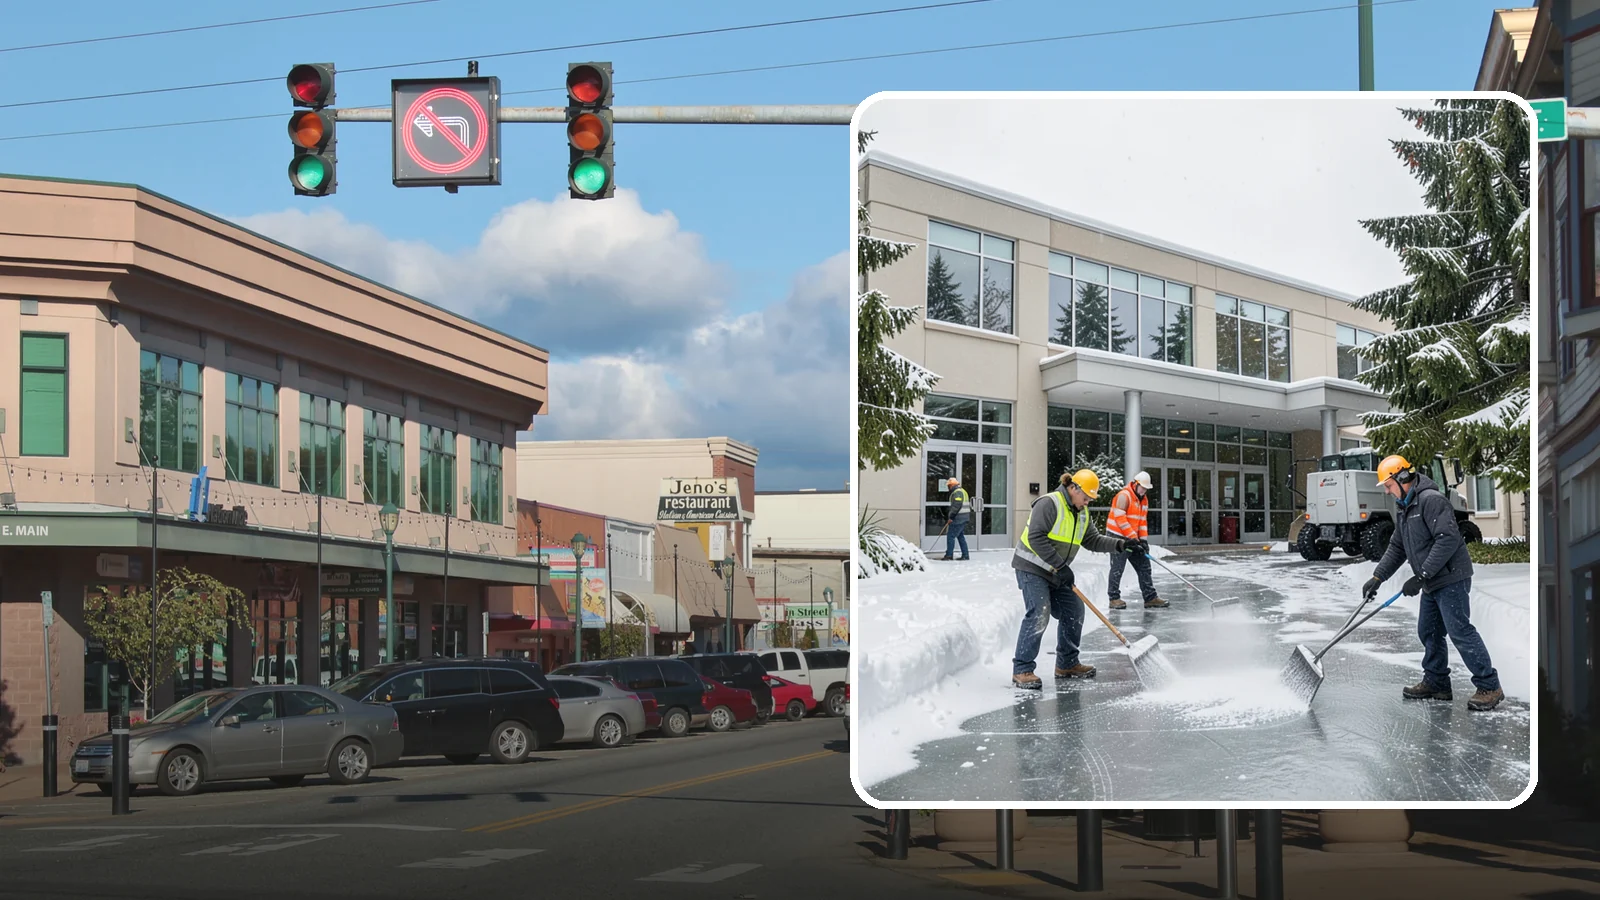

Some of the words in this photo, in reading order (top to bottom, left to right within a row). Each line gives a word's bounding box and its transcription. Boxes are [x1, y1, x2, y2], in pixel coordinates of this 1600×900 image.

[670, 480, 727, 494] Jeno's
[665, 496, 731, 509] restaurant
[658, 509, 681, 520] Italian
[686, 509, 714, 519] American
[715, 509, 737, 519] Cuisine
[2, 525, 13, 536] E.
[15, 525, 49, 536] MAIN
[797, 607, 829, 617] Street
